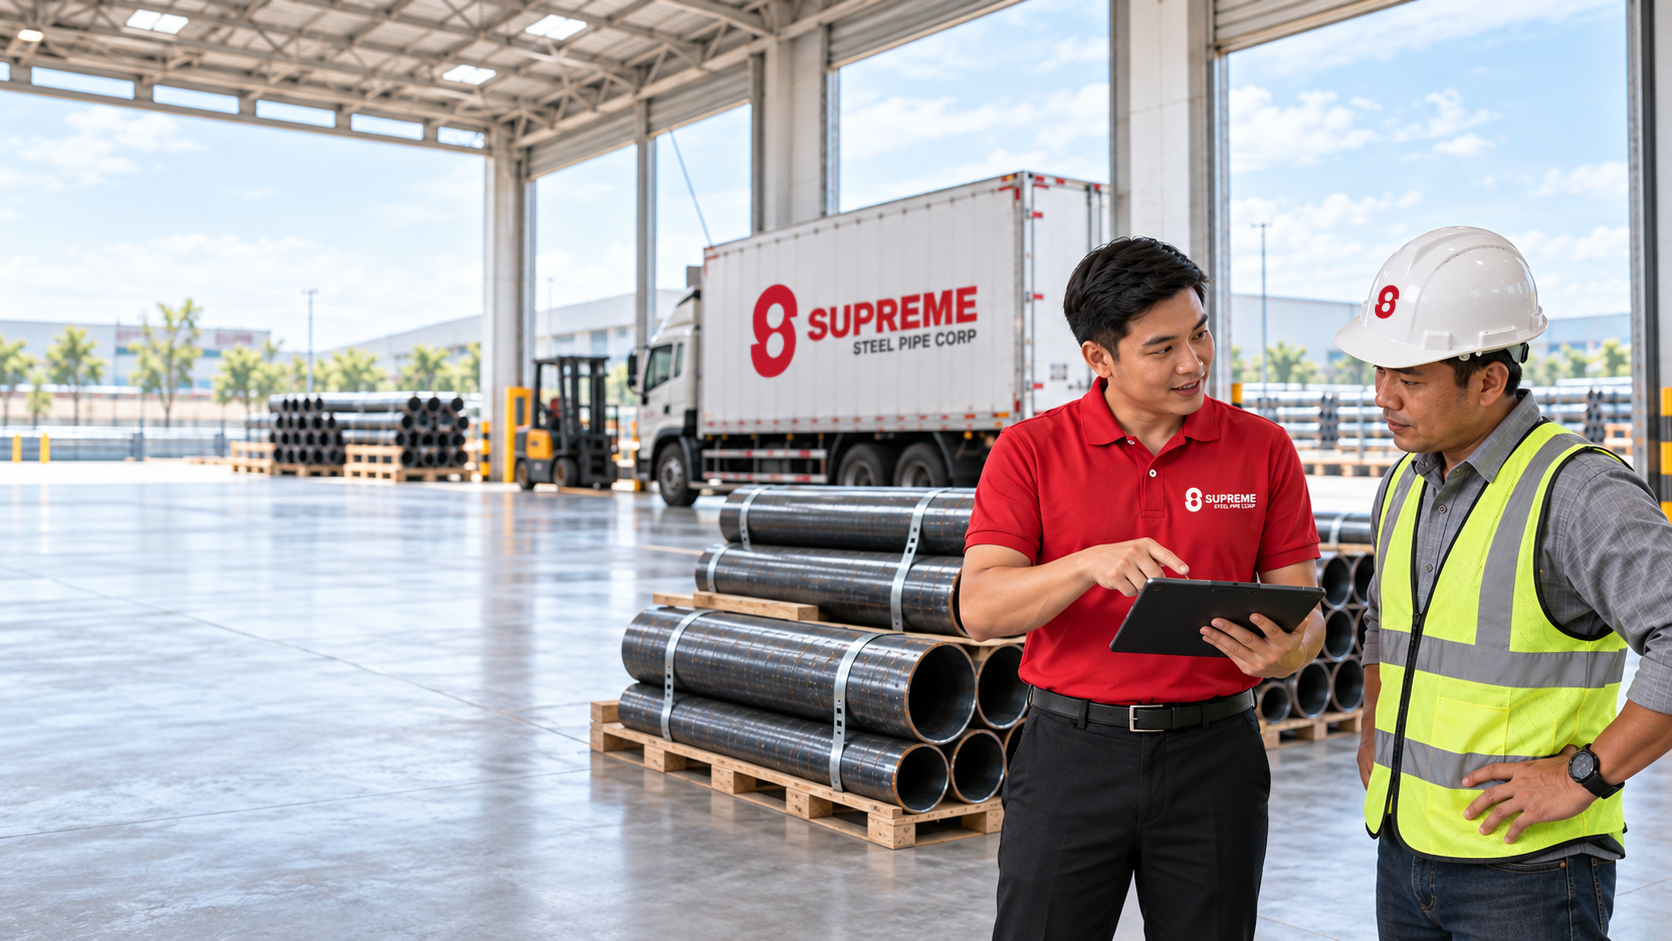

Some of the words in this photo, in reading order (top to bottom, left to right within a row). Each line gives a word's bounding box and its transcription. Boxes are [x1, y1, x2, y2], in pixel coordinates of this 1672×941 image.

[807, 285, 978, 341] SUPREME
[853, 338, 894, 355] STEEL
[899, 334, 930, 350] PIPE
[935, 329, 977, 347] CORP
[1205, 494, 1256, 503] SUPREME
